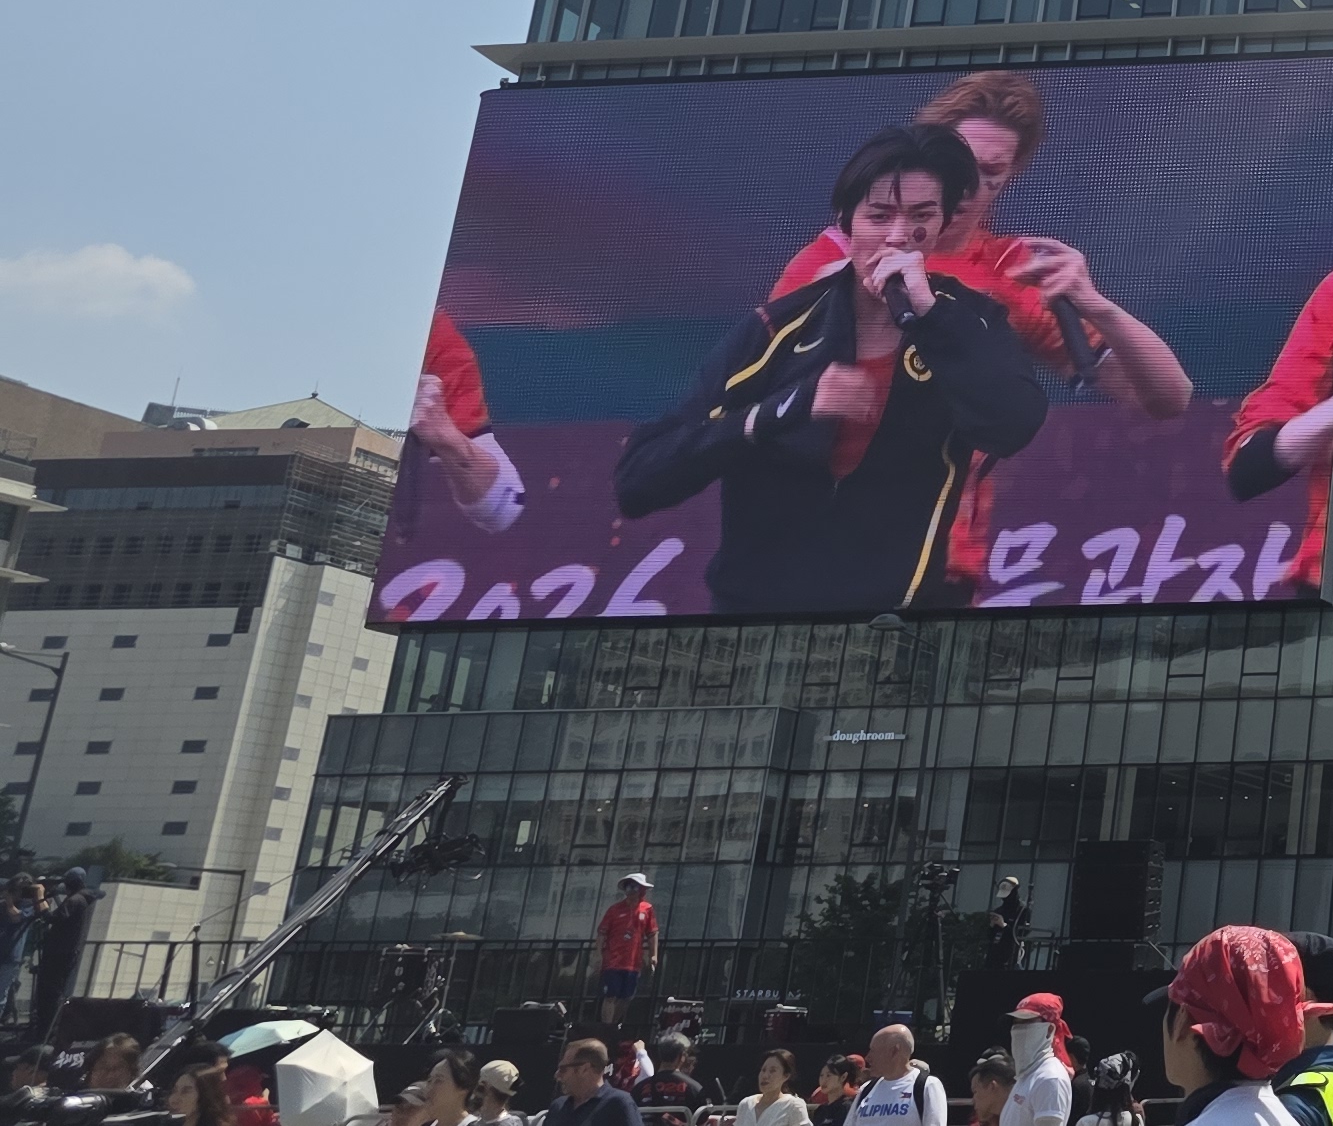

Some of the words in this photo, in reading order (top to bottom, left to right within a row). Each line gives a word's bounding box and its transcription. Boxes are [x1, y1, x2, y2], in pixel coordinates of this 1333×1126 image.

[832, 729, 895, 744] doughroom
[735, 989, 802, 999] STARBU
[858, 1102, 910, 1118] ILIPINAS
